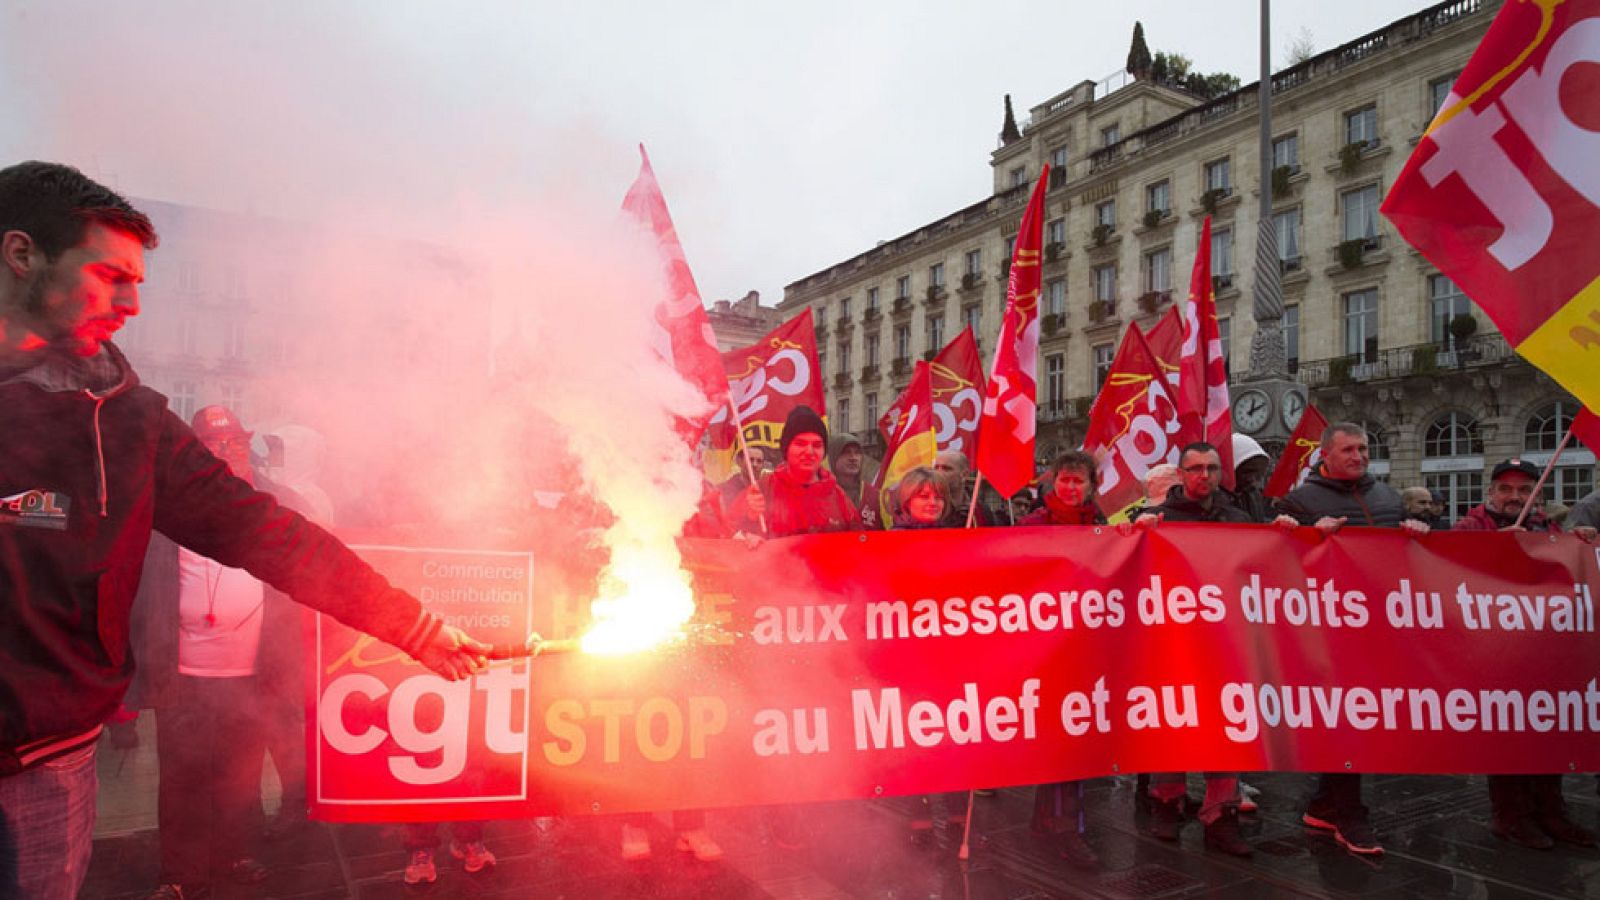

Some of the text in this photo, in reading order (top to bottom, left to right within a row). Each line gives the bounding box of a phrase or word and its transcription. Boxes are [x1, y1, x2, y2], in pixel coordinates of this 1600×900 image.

[420, 586, 524, 604] Distribution
[422, 560, 525, 580] Commerce
[752, 604, 849, 646] aux
[866, 589, 1126, 640] massacres
[1138, 575, 1226, 626] des
[1241, 575, 1369, 628] droits
[1386, 580, 1444, 629] du
[1457, 582, 1594, 632] travail
[320, 659, 526, 785] cgt
[543, 675, 1600, 766] STOP au Medef et au gouvernement
